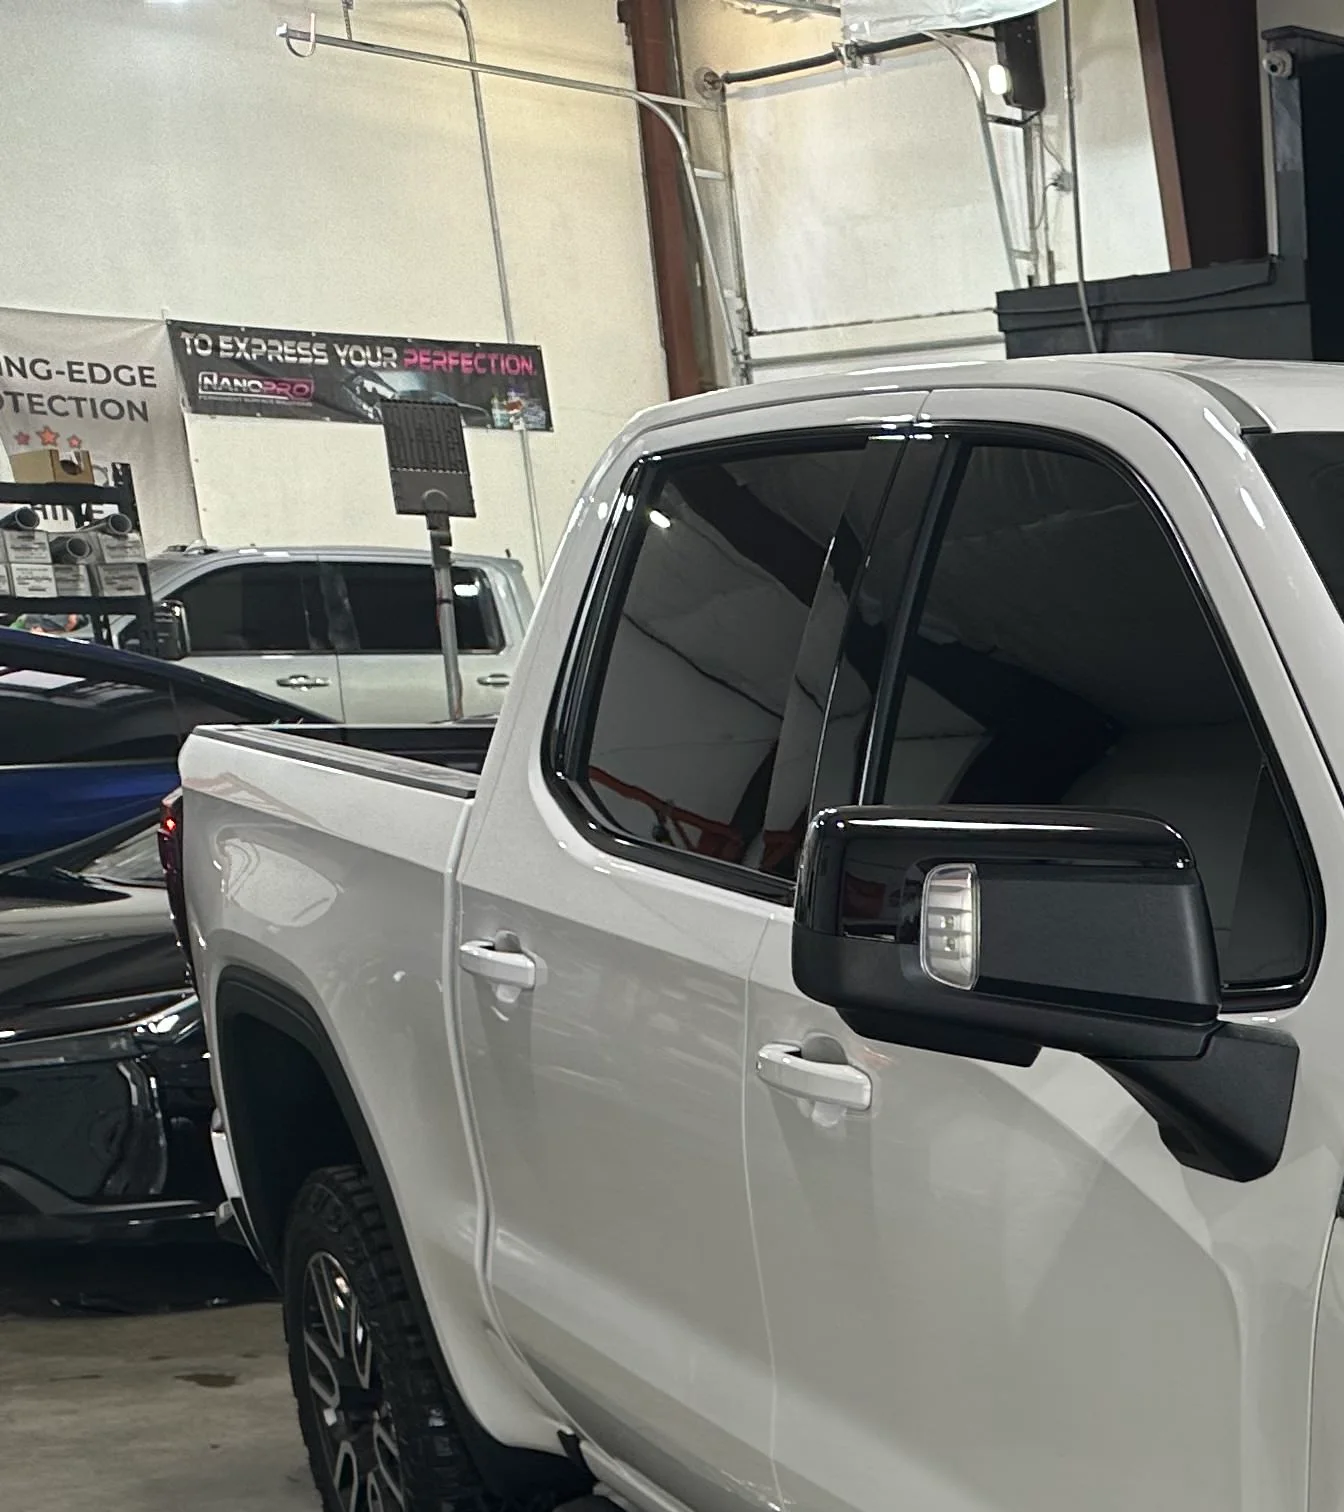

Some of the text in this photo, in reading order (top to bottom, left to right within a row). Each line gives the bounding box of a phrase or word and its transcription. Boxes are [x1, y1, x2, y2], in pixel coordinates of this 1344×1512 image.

[180, 332, 537, 376] TO EXPRESS YOUR PERFECTION.
[202, 373, 311, 398] NANOPRO
[0, 391, 149, 422] TECTION
